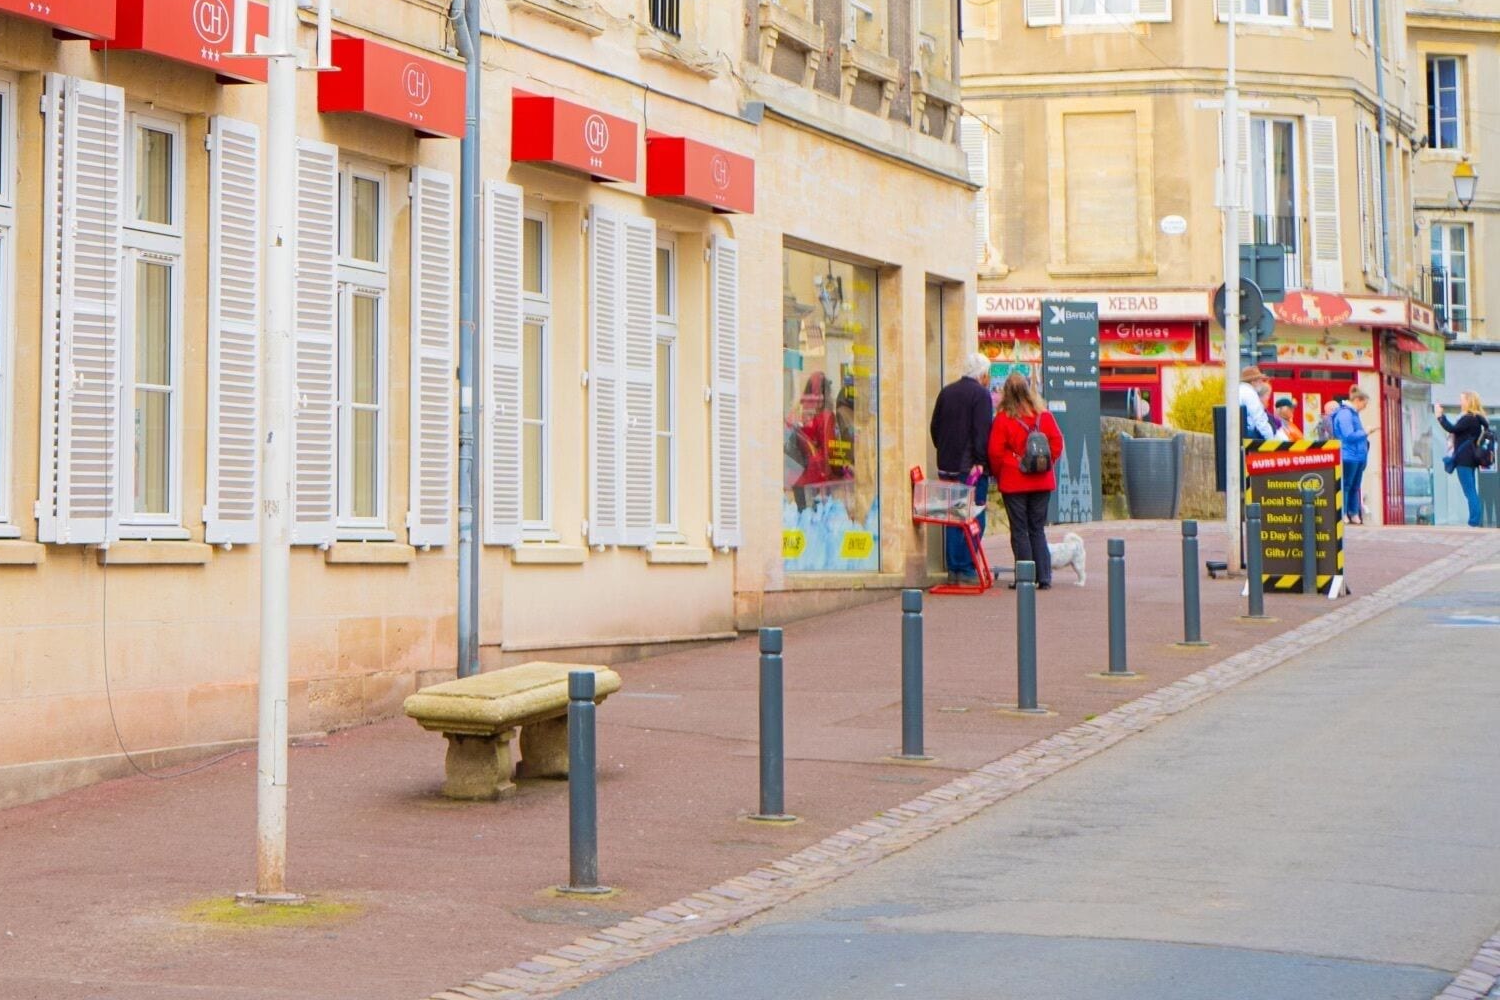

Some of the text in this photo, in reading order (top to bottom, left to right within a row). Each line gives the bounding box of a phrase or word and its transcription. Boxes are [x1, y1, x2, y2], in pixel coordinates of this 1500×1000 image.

[199, 1, 222, 37] CH
[407, 69, 425, 100] CH
[589, 120, 605, 148] CH
[1109, 296, 1159, 311] KEBAB
[1292, 453, 1335, 466] COMMUN
[1262, 496, 1328, 506] Local Souirs
[1267, 513, 1292, 523] Books
[1270, 531, 1287, 541] Day
[1265, 548, 1285, 558] Gifts
[1292, 548, 1326, 558] Caux
